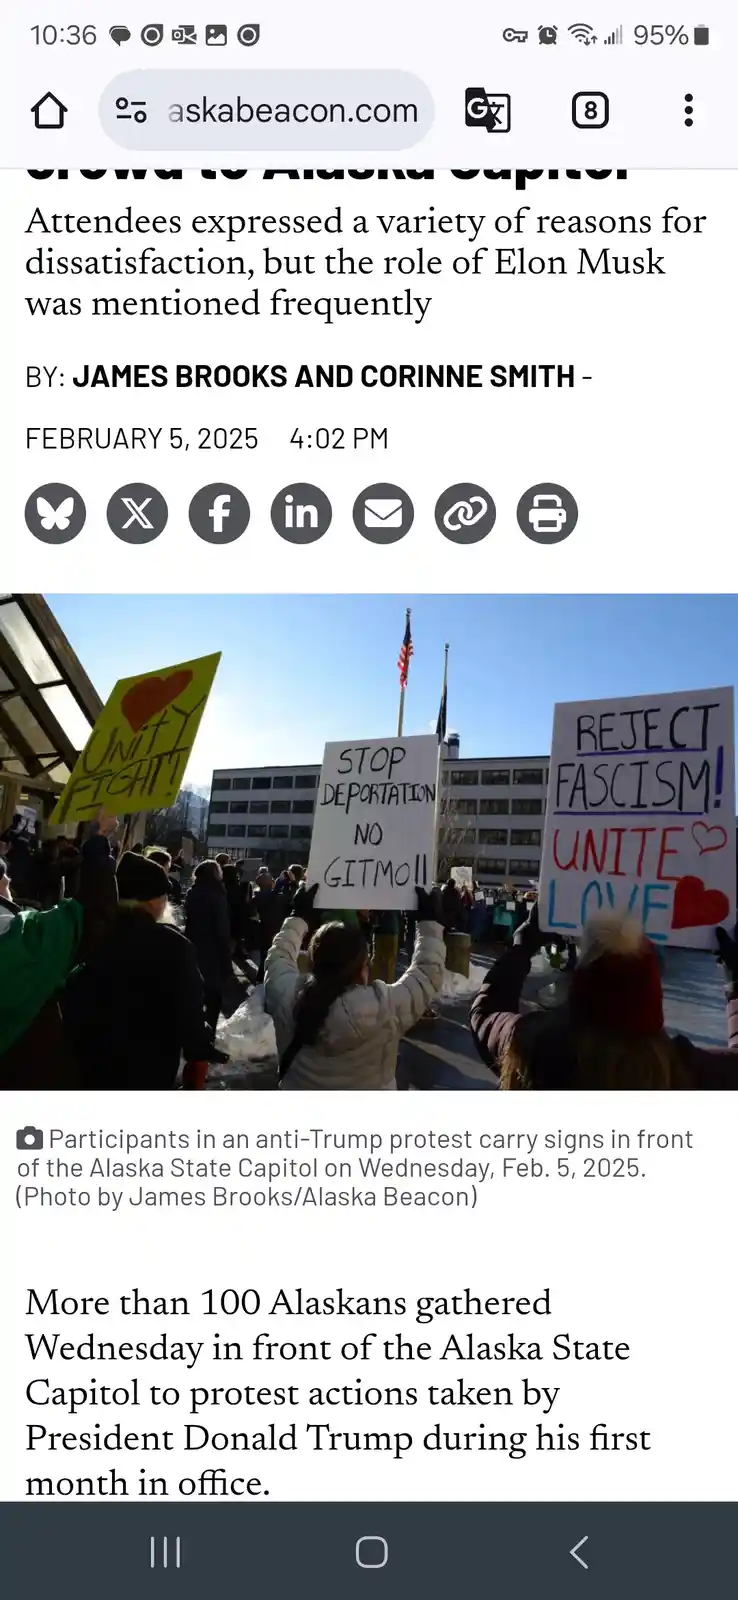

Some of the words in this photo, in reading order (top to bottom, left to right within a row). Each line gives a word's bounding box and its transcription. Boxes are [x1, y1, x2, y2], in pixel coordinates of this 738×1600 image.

[30, 24, 97, 46] 10:36
[633, 24, 690, 46] 95%
[168, 95, 418, 123] askabeacon.com
[584, 100, 598, 120] 8
[25, 206, 182, 234] Attendees
[191, 206, 344, 243] expressed
[352, 215, 370, 234] a
[376, 206, 487, 243] variety
[494, 206, 531, 234] of
[537, 215, 652, 234] reasons
[661, 206, 708, 234] for
[25, 246, 255, 281] dissatisfaction,
[263, 247, 316, 275] but
[324, 247, 374, 275] the
[384, 247, 443, 275] role
[452, 246, 489, 275] of
[494, 247, 568, 276] Elon
[576, 247, 667, 275] Musk
[25, 297, 82, 317] was
[91, 288, 261, 316] mentioned
[269, 287, 433, 325] frequently
[26, 366, 65, 388] BY:
[72, 365, 169, 388] JAMES
[175, 365, 288, 388] BROOKS
[295, 365, 354, 388] AND
[360, 365, 483, 388] CORINNE
[489, 365, 575, 388] SMITH
[26, 428, 163, 450] FEBRUARY
[169, 428, 190, 453] 5,
[197, 428, 258, 450] 2025
[289, 428, 346, 450] 4:02
[353, 428, 389, 450] PM
[285, 495, 319, 528] in
[577, 704, 720, 752] REJECT
[337, 747, 406, 779] STOP
[557, 746, 724, 813] FASCISM!
[320, 782, 436, 814] DEPORTATION
[354, 823, 383, 845] NO
[553, 827, 684, 881] UNITE
[49, 1129, 190, 1155] Participants
[196, 1129, 216, 1149] in
[222, 1133, 249, 1149] an
[255, 1129, 383, 1155] anti-Trump
[390, 1130, 473, 1155] protest
[479, 1133, 538, 1155] carry
[544, 1129, 604, 1155] signs
[611, 1129, 630, 1149] in
[636, 1129, 694, 1149] front
[17, 1158, 40, 1178] of
[46, 1158, 83, 1178] the
[89, 1158, 164, 1178] Alaska
[170, 1158, 231, 1178] State
[238, 1158, 317, 1183] Capitol
[324, 1162, 352, 1178] on
[358, 1158, 495, 1183] Wednesday,
[503, 1158, 550, 1178] Feb.
[557, 1158, 577, 1181] 5,
[583, 1158, 646, 1178] 2025.
[15, 1185, 91, 1209] (Photo
[98, 1187, 124, 1212] by
[129, 1187, 206, 1207] James
[213, 1186, 376, 1208] Brooks/Alaska
[384, 1185, 478, 1209] Beacon)
[25, 1288, 110, 1316] More
[119, 1288, 191, 1316] than
[201, 1289, 261, 1316] 100
[268, 1288, 407, 1316] Alaskans
[415, 1288, 552, 1324] gathered
[25, 1333, 205, 1369] Wednesday
[212, 1333, 244, 1361] in
[252, 1332, 332, 1361] front
[340, 1332, 378, 1361] of
[383, 1333, 432, 1361] the
[439, 1333, 544, 1361] Alaska
[552, 1333, 630, 1361] State
[25, 1378, 141, 1414] Capitol
[149, 1386, 180, 1406] to
[189, 1386, 300, 1415] protest
[308, 1378, 418, 1406] actions
[427, 1378, 514, 1406] taken
[521, 1378, 561, 1415] by
[25, 1423, 175, 1451] President
[183, 1423, 298, 1451] Donald
[306, 1423, 413, 1459] Trump
[423, 1423, 528, 1459] during
[535, 1423, 580, 1451] his
[589, 1423, 652, 1451] first
[25, 1468, 130, 1496] month
[138, 1468, 170, 1496] in
[178, 1467, 271, 1496] office.
